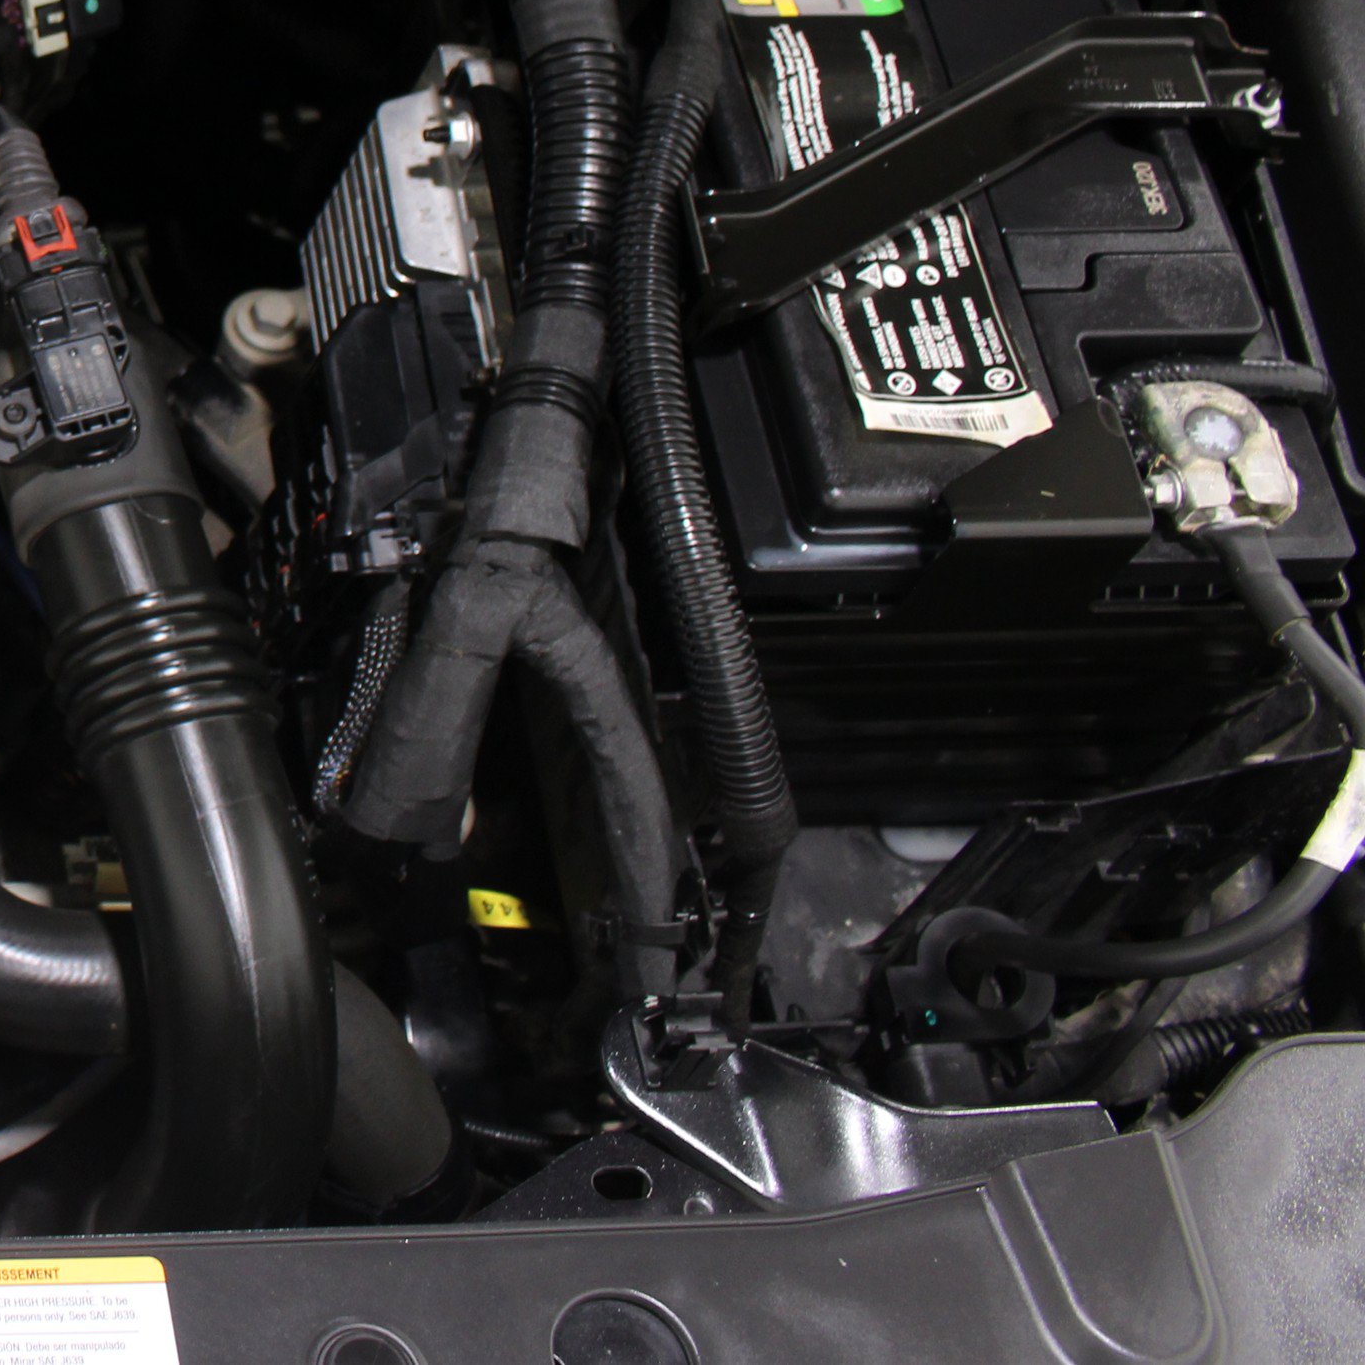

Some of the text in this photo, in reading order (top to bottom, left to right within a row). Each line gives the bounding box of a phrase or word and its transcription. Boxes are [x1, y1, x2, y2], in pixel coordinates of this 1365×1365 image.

[14, 1297, 39, 1308] HIGH
[101, 1295, 113, 1307] To
[115, 1295, 129, 1306] be
[3, 1312, 42, 1325] persons
[68, 1310, 88, 1321] See
[89, 1310, 109, 1321] SAE
[25, 1341, 50, 1352] Debe
[53, 1342, 67, 1351] ser
[70, 1340, 126, 1352] manipulado
[10, 1356, 35, 1365] Mirar
